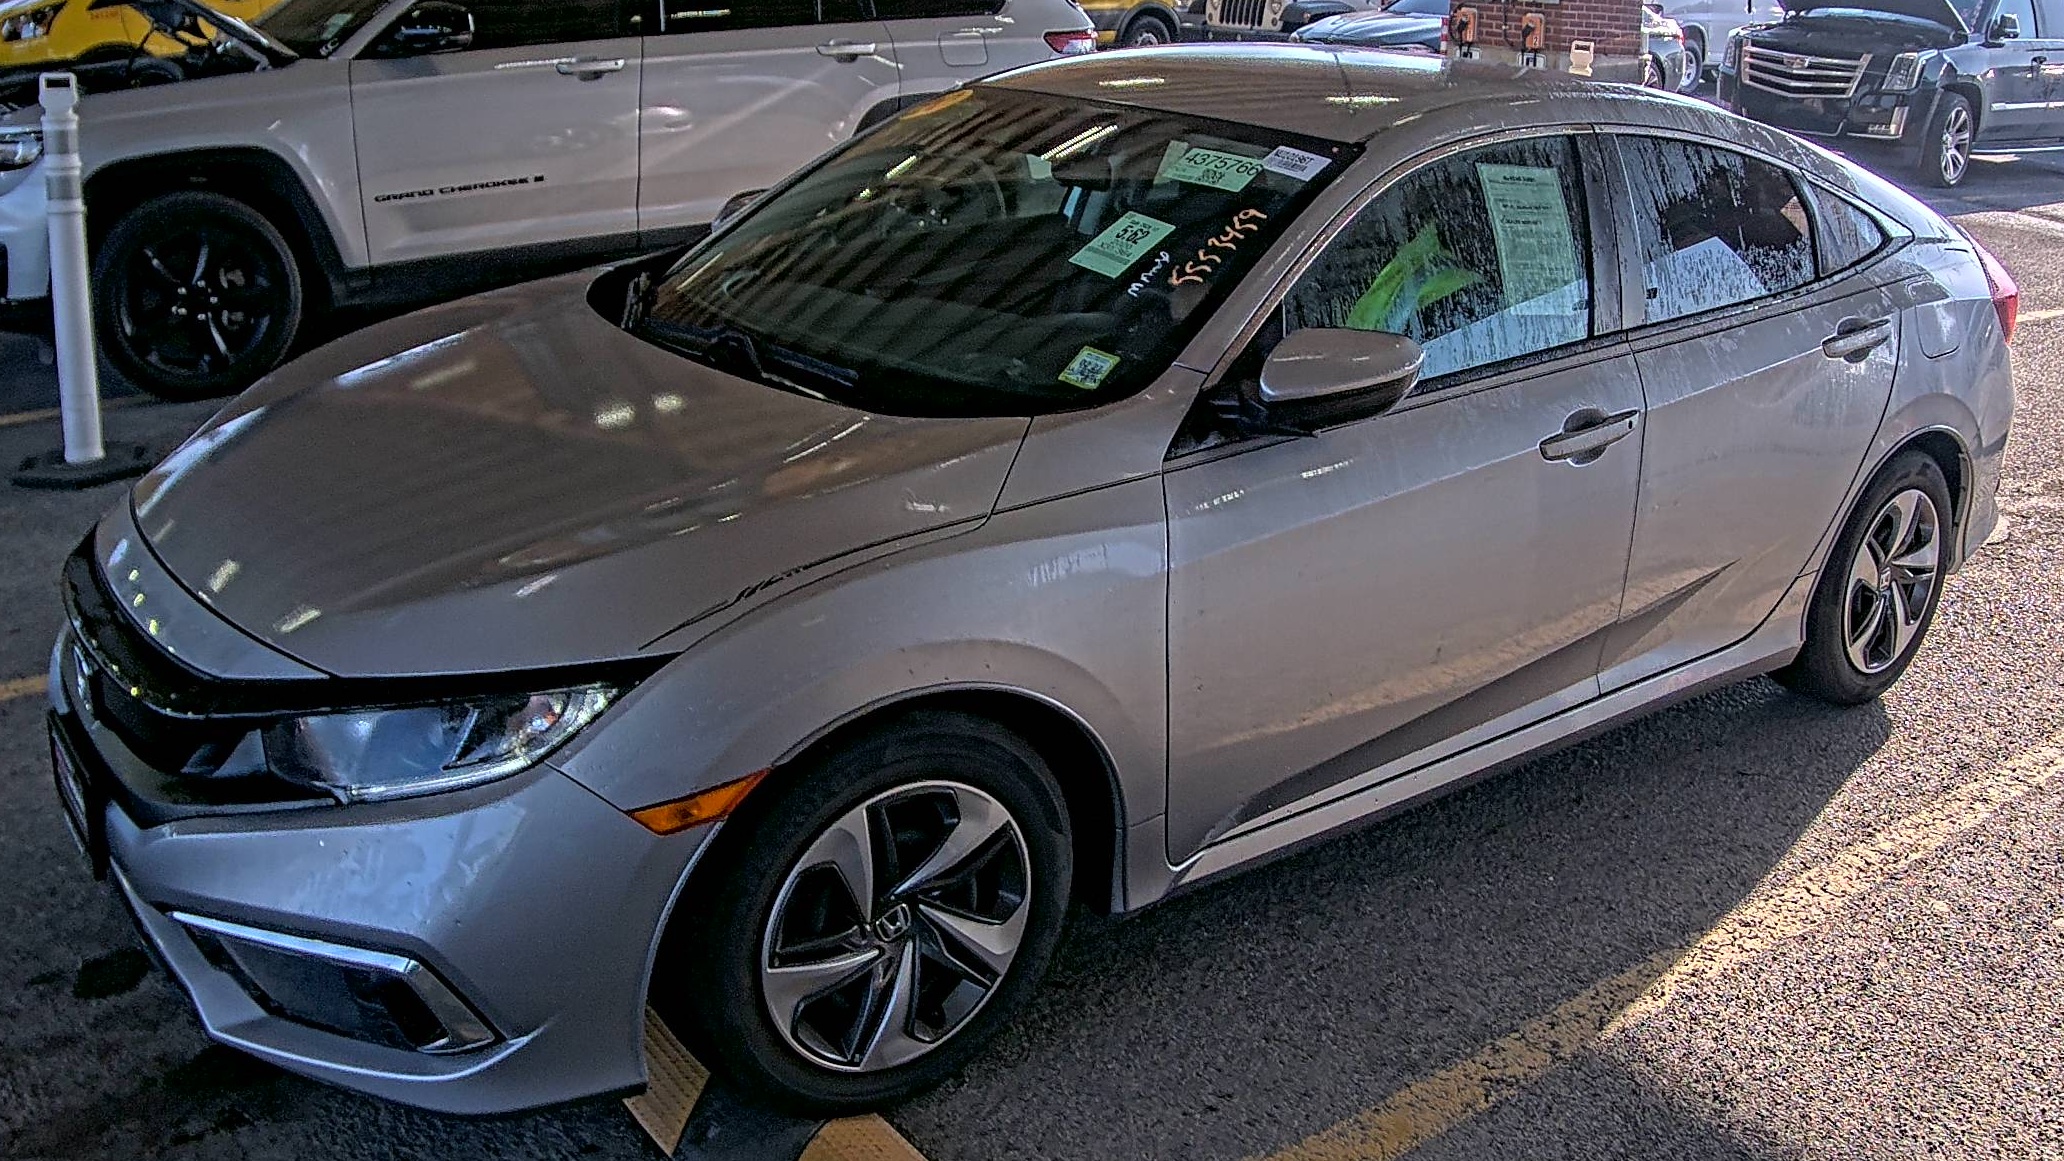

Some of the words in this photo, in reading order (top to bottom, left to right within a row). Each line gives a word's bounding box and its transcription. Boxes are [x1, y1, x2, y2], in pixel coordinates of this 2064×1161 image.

[1185, 152, 1264, 176] 4375766
[374, 188, 434, 203] GRAND
[439, 177, 529, 194] CHEROKEE
